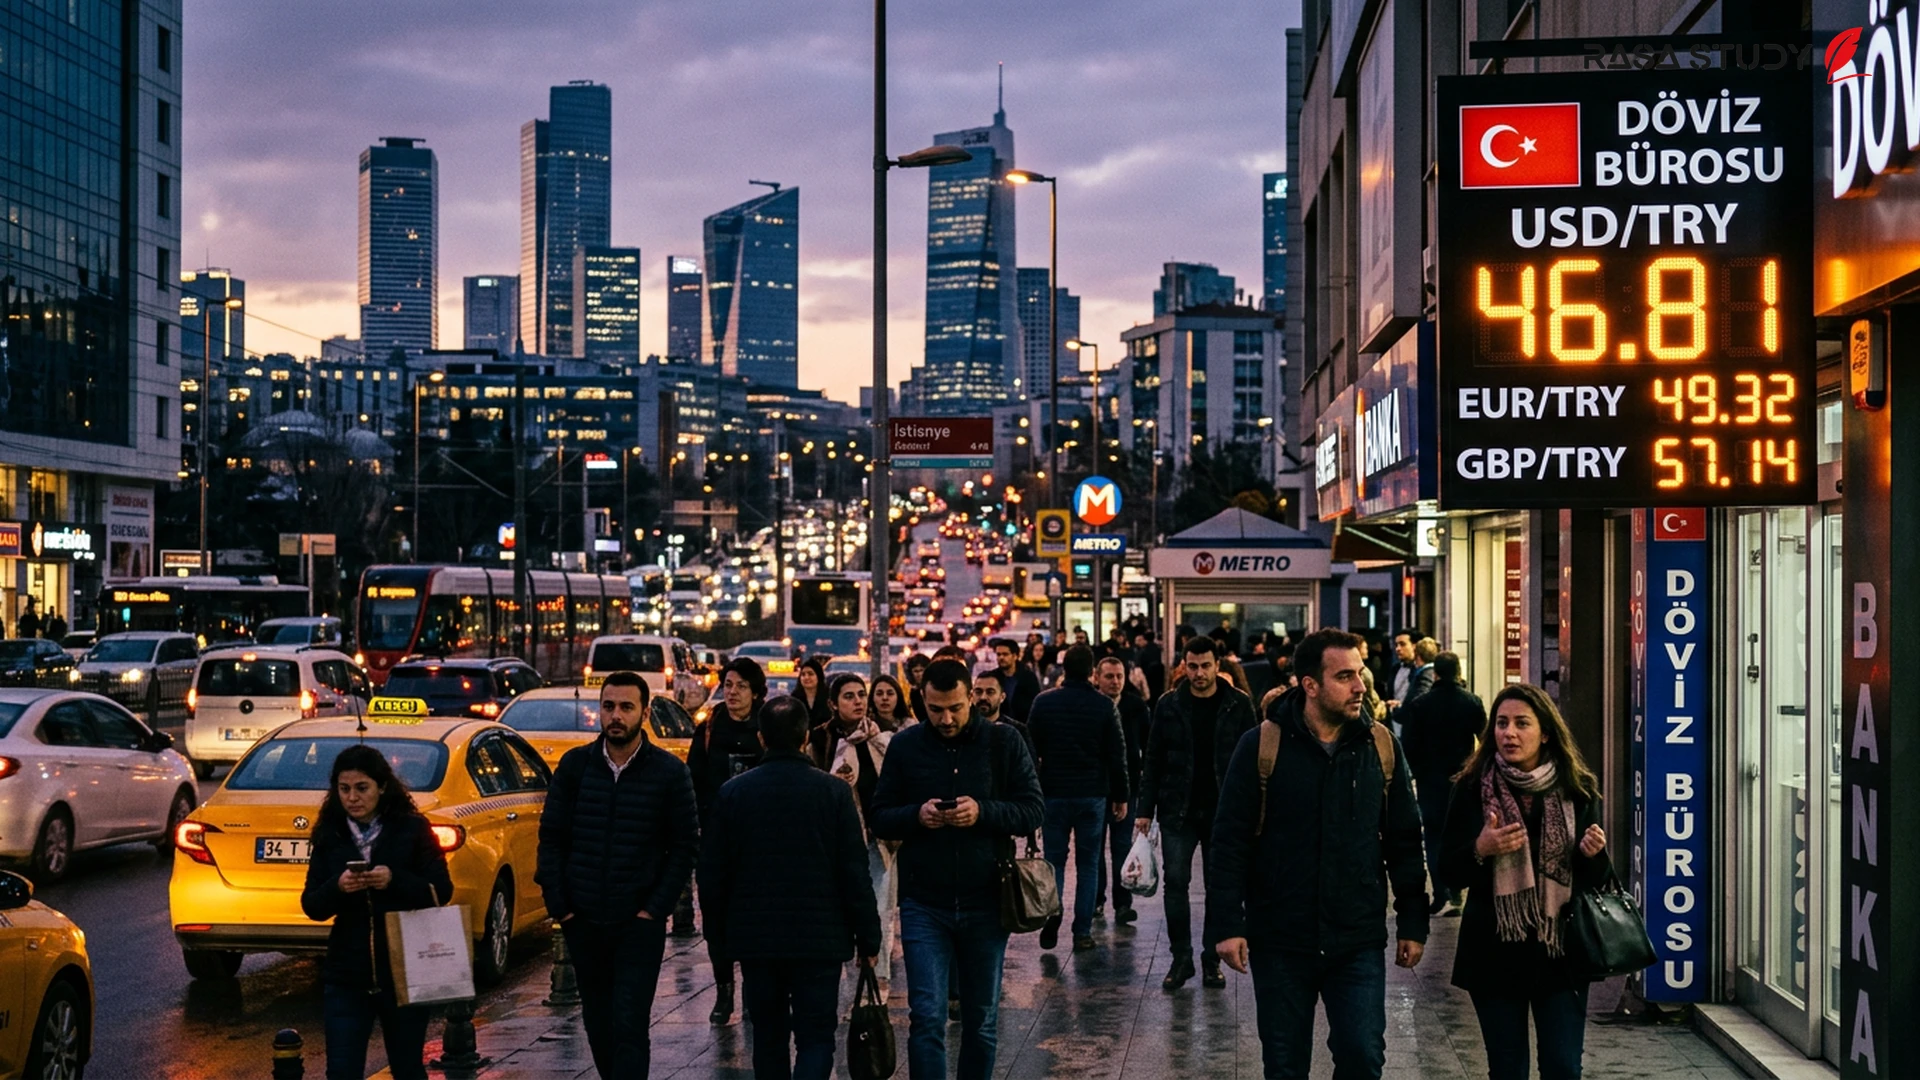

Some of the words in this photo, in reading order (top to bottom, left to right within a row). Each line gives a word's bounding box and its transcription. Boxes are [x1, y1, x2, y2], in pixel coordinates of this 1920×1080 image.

[1618, 89, 1762, 136] DÖVİZ
[1596, 142, 1784, 187] BÜROSU
[1511, 202, 1739, 249] USD/TRY
[1476, 256, 1779, 363] 46.81
[1458, 385, 1626, 420] EUR/TRY
[1653, 374, 1796, 425] 49.32
[894, 423, 951, 441] Istisnye
[1365, 388, 1402, 477] BANKA
[1456, 446, 1627, 480] GBP/TRY
[1653, 438, 1796, 488] 57.14
[1078, 483, 1116, 518] M
[1074, 538, 1121, 551] METRO
[1219, 555, 1291, 572] METRO
[1664, 569, 1696, 744] DÖVİZ
[266, 841, 283, 857] 34
[290, 841, 300, 856] T
[1850, 581, 1879, 1075] BANKA
[1663, 773, 1695, 989] BÜROSU
